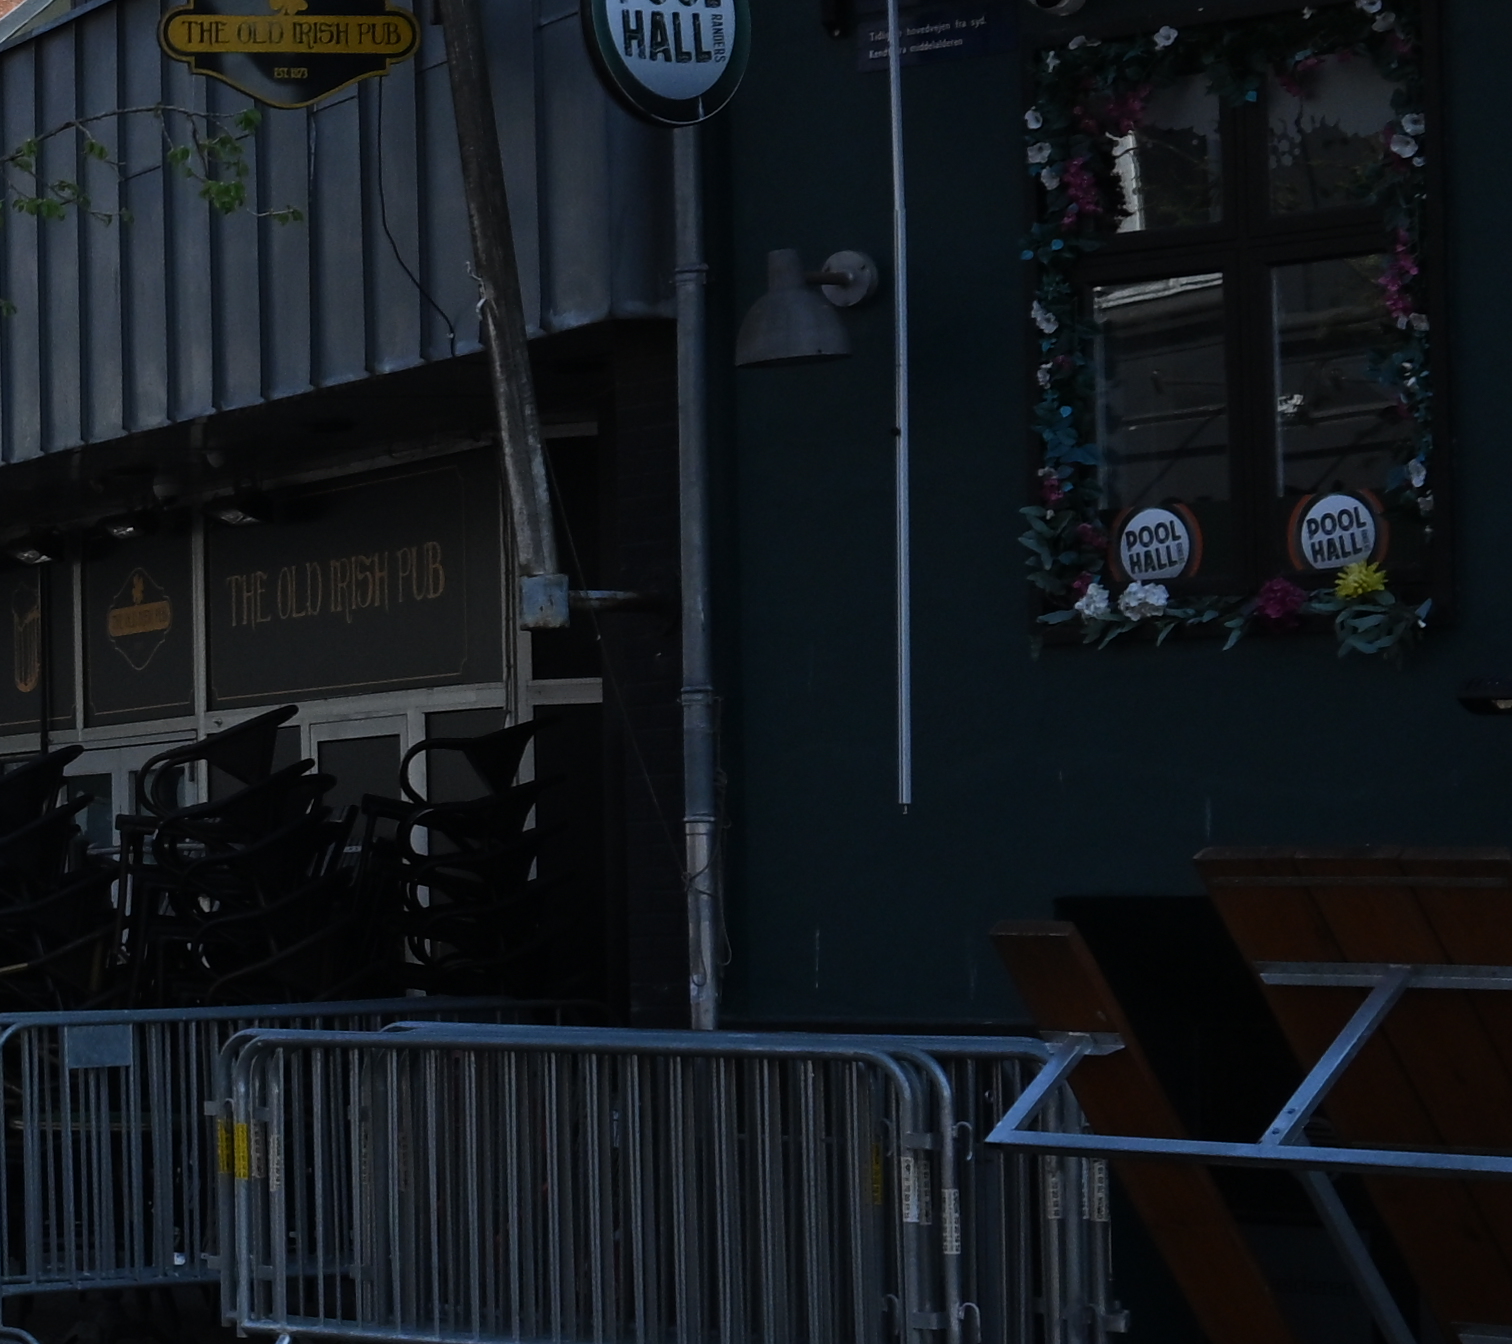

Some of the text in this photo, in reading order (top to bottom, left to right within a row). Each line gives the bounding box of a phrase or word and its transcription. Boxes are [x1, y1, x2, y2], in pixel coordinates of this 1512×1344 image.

[182, 20, 402, 50] THE OLD IRISH PUB
[621, 9, 713, 64] HALL
[711, 13, 727, 64] RANDERS
[1125, 519, 1182, 552] POOL
[1306, 506, 1367, 540] POOL
[1128, 545, 1178, 574] HALL
[1310, 532, 1363, 564] HALL
[226, 569, 272, 631] THE
[277, 561, 323, 620] OLD
[330, 551, 390, 624] IRISH
[396, 541, 446, 603] PUB
